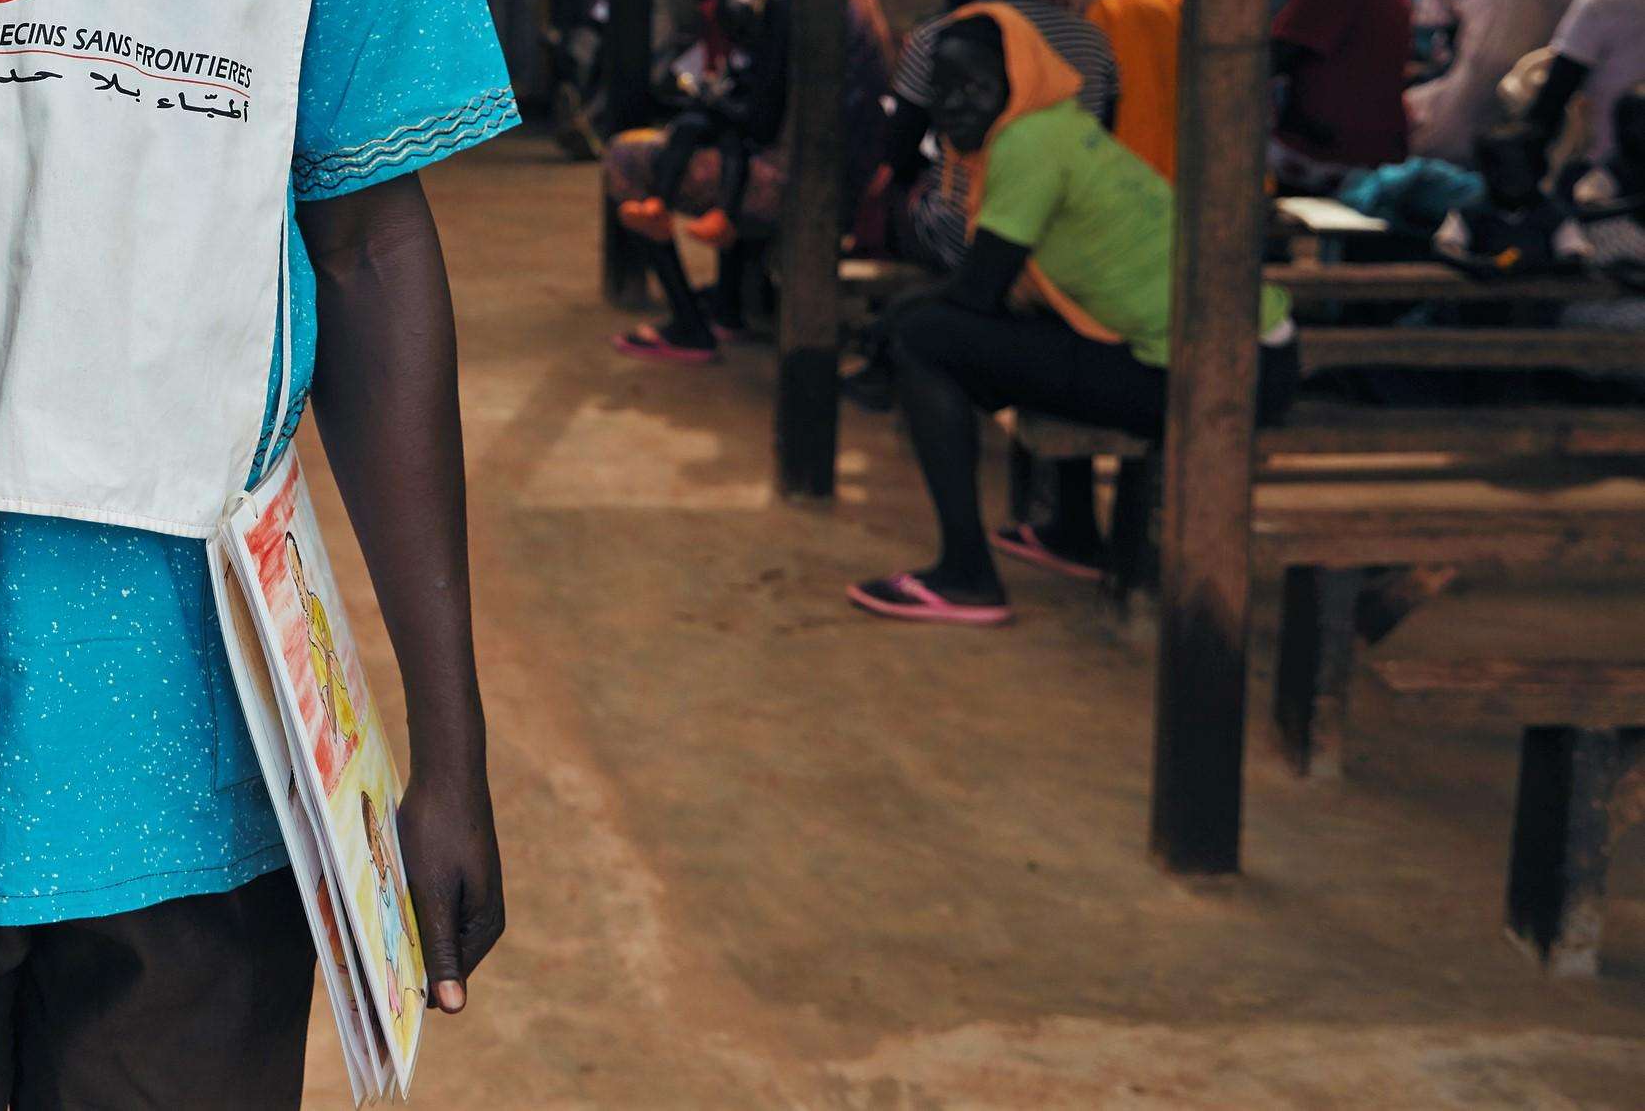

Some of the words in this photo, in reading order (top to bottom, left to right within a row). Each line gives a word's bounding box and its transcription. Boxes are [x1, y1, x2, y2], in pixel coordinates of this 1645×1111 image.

[72, 28, 133, 58] SANS
[135, 42, 253, 90] FRONTIERES
[89, 71, 142, 103] بلا
